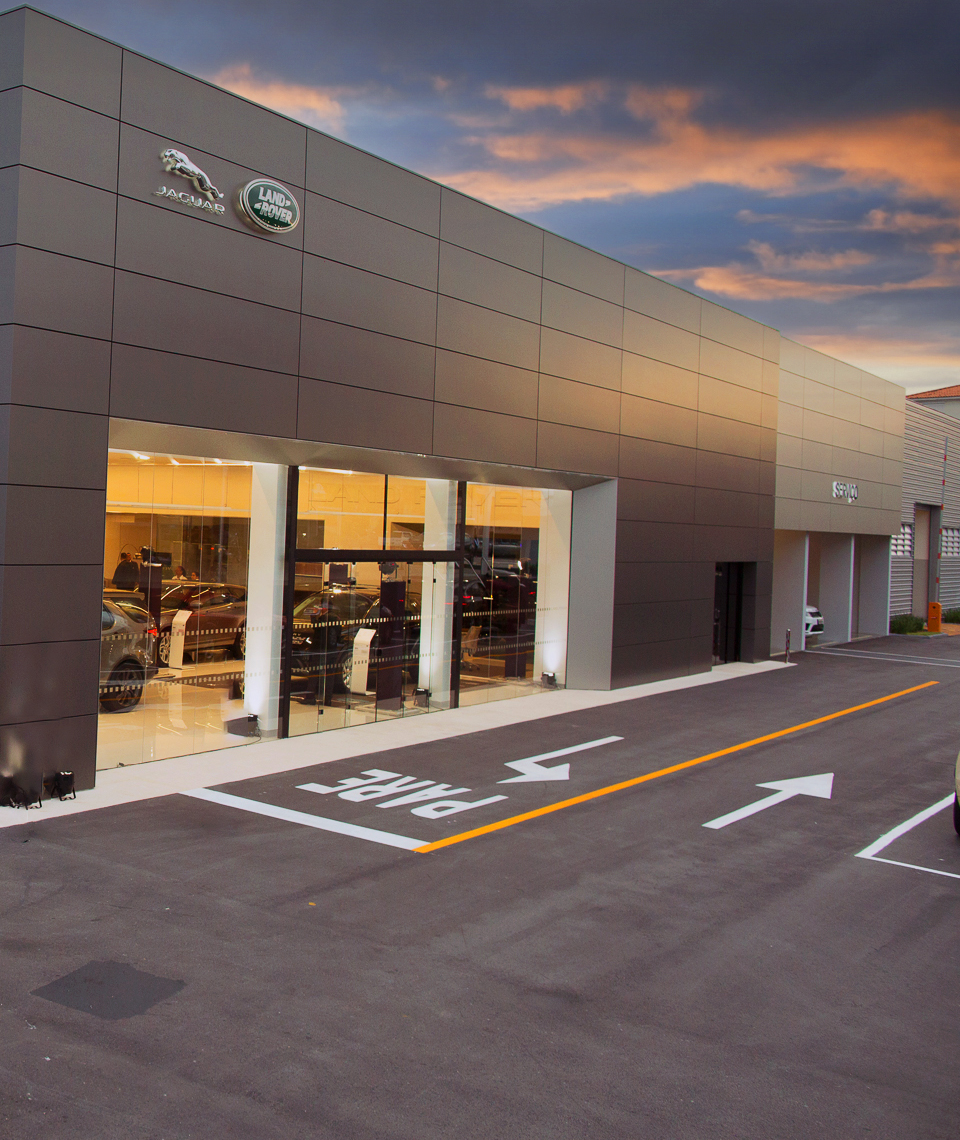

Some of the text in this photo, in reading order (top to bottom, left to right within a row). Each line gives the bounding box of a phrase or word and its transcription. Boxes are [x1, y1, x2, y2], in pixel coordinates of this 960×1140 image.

[155, 185, 226, 216] JAGUAR
[258, 186, 286, 207] LAND
[259, 201, 293, 225] ROVER
[295, 768, 509, 820] PARE
